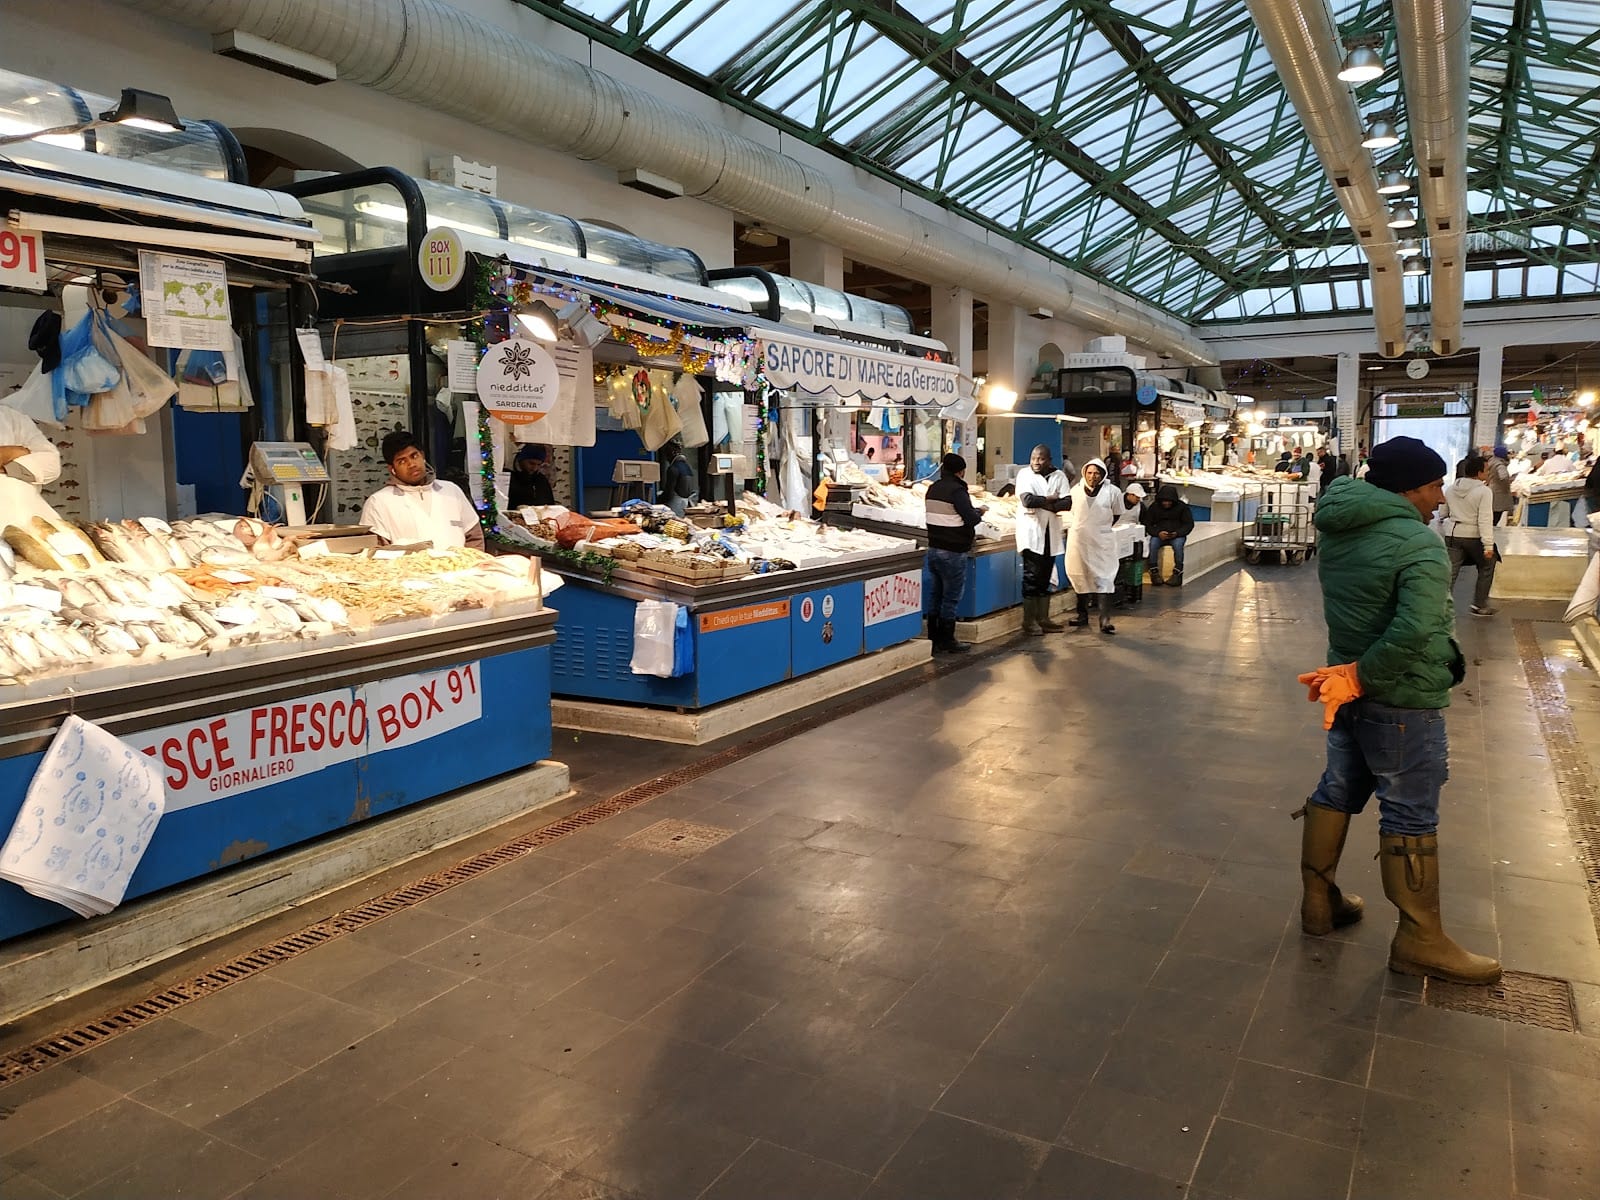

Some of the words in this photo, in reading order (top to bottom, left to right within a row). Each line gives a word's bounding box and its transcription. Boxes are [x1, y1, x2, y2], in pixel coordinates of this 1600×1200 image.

[0, 231, 37, 273] 91
[430, 241, 450, 253] BOX
[430, 256, 451, 276] 111
[766, 342, 836, 379] SAPORE
[838, 355, 853, 382] DI
[856, 358, 895, 388] MARE
[895, 365, 911, 389] da
[911, 365, 955, 394] Gerardo
[490, 383, 544, 394] nieddittas
[495, 400, 538, 409] SARDEGNA
[864, 580, 891, 622] PESCE
[892, 575, 921, 608] FRESCO
[250, 698, 367, 760] FRESCO
[377, 679, 444, 744] BOX
[447, 664, 476, 704] 91
[209, 758, 294, 792] GIORNALIERO
